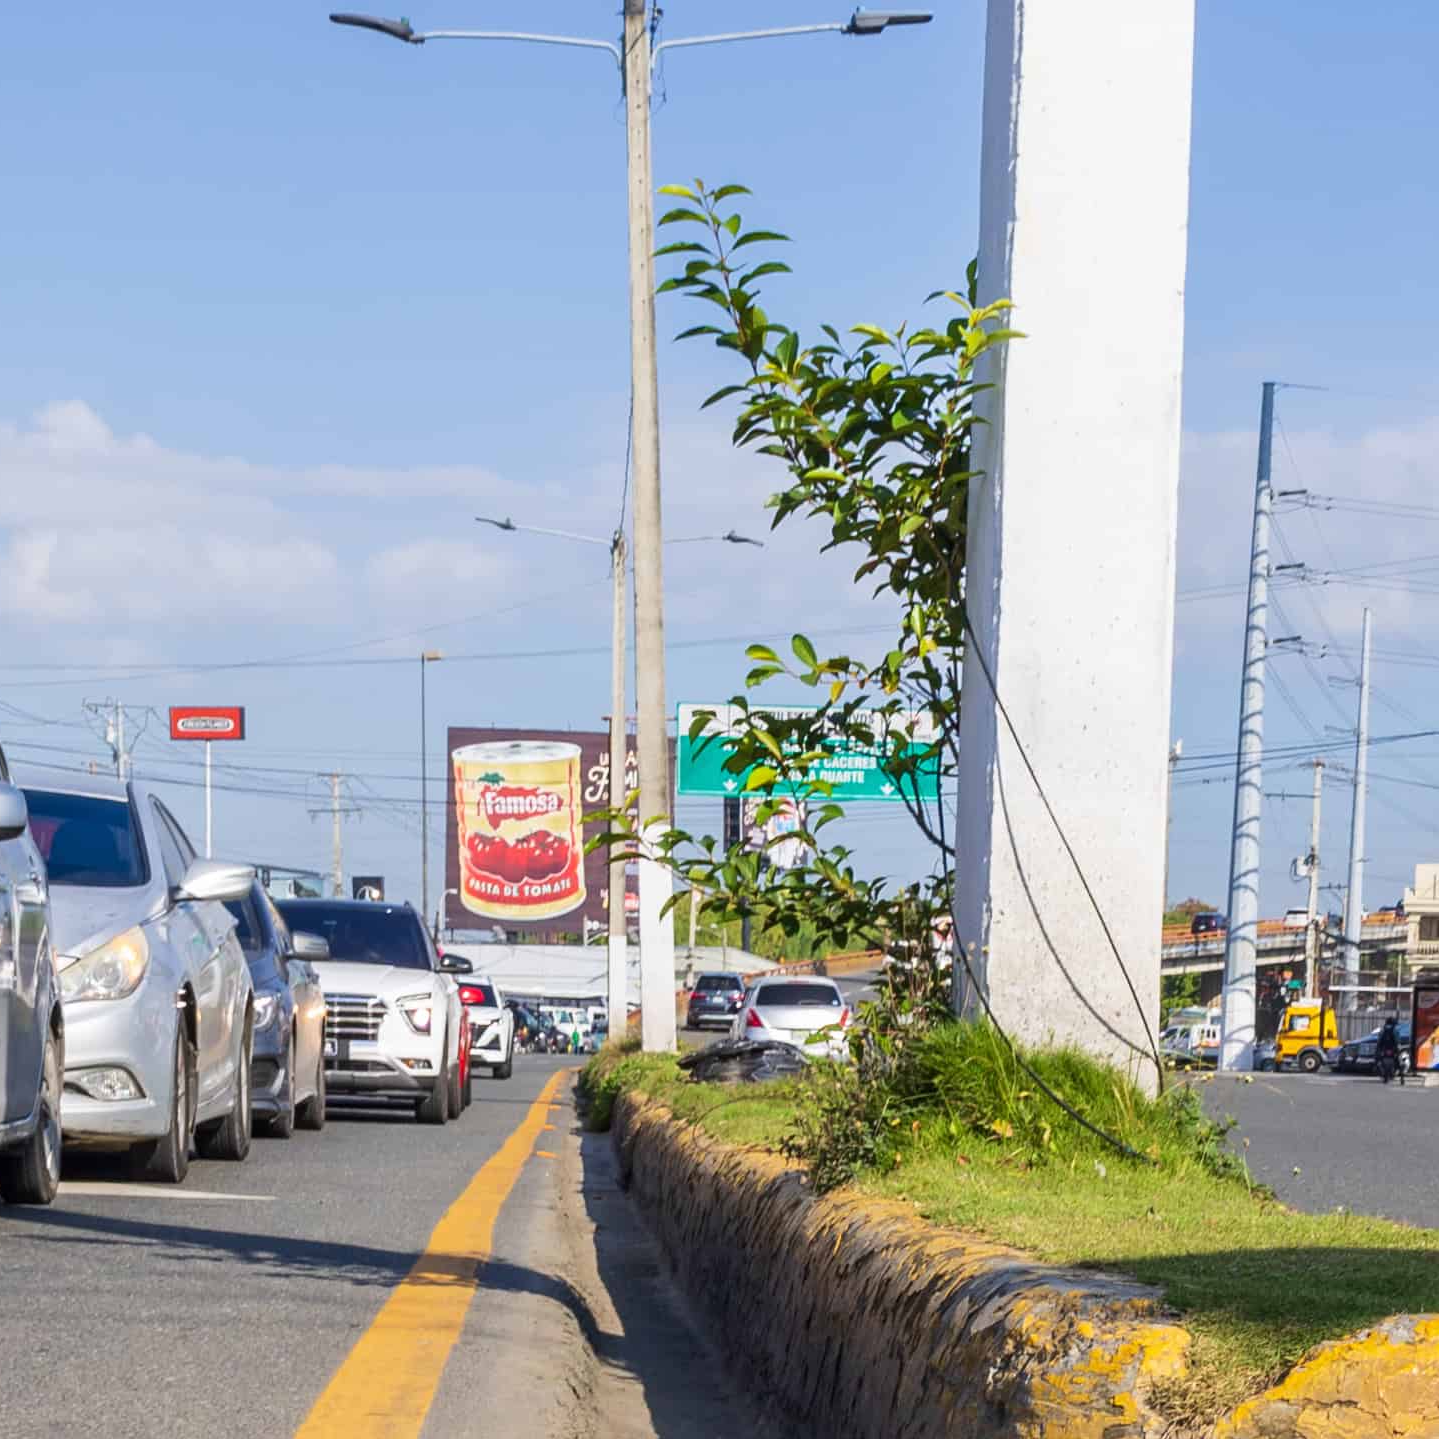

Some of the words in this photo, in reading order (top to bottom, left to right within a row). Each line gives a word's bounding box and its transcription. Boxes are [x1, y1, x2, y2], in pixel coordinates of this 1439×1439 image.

[484, 788, 559, 815] Famosa
[469, 877, 500, 896] PASTA
[504, 884, 519, 897] DE
[524, 877, 571, 897] TOMATE
